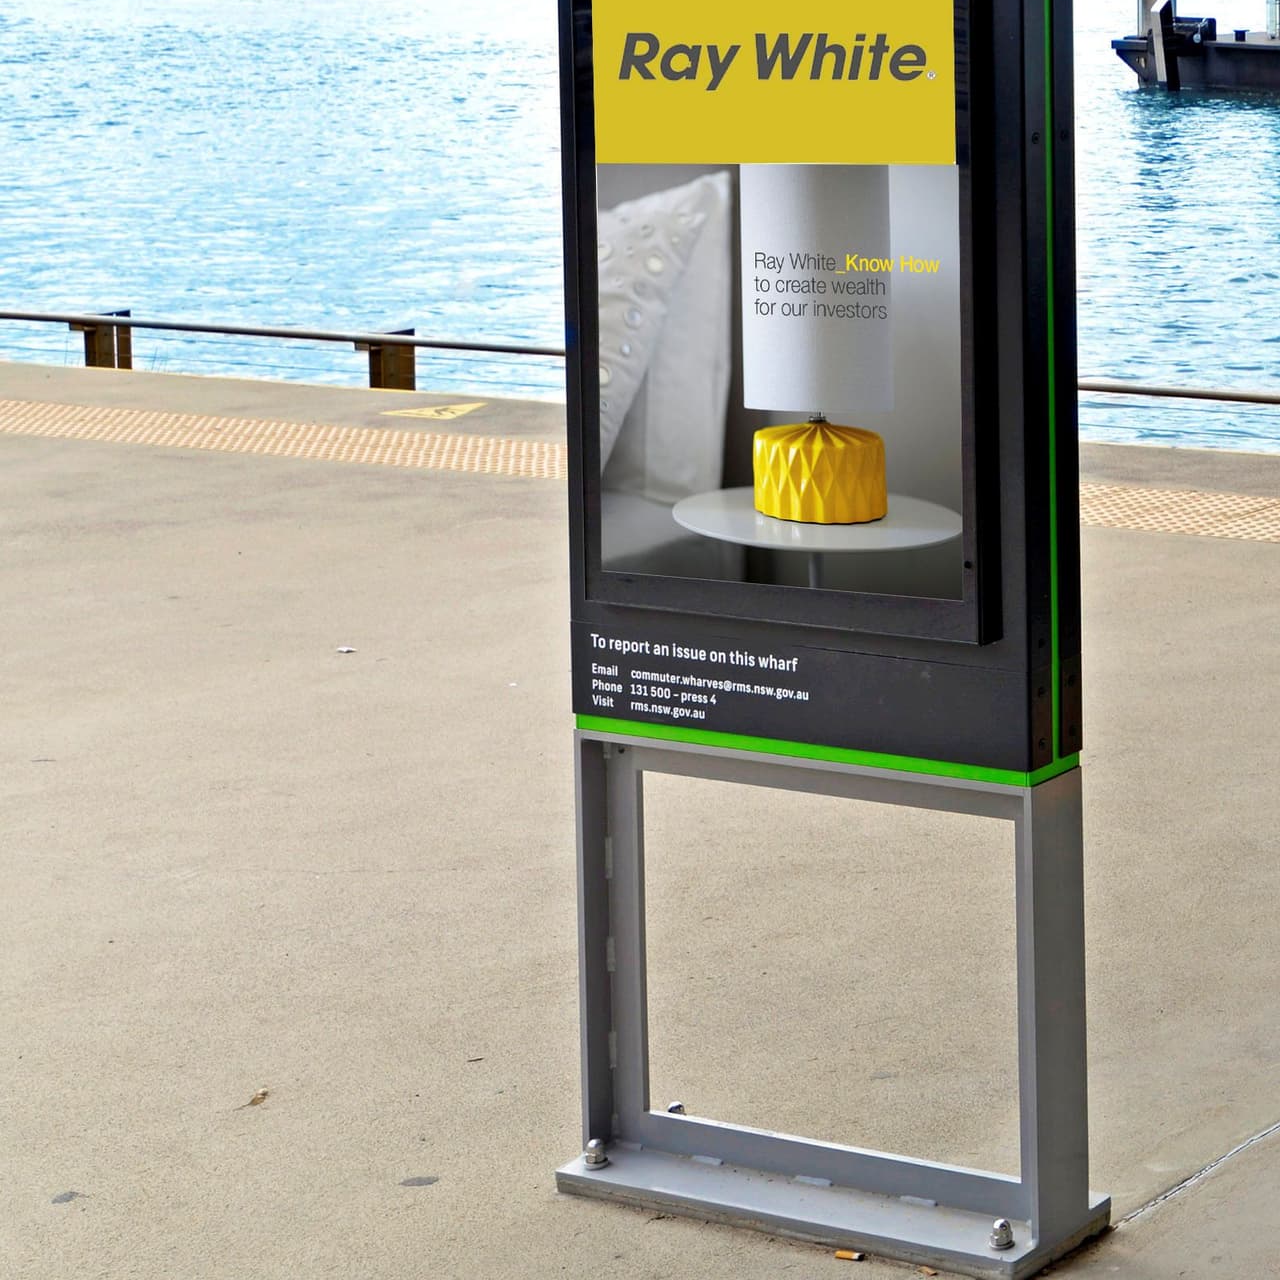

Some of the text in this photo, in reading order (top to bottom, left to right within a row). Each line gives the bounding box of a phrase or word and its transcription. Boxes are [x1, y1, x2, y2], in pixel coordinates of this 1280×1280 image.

[618, 32, 927, 91] Ray White
[754, 251, 785, 274] Ray
[900, 255, 940, 273] How
[754, 276, 886, 296] to create wealth
[754, 298, 888, 320] for our investors
[590, 633, 799, 673] To report an issue on this wharf
[592, 663, 810, 701] Email commuter.wharves@rms.nsw.gov.au
[592, 679, 623, 693] Phone
[630, 684, 648, 697] 131
[650, 686, 671, 699] 500
[681, 692, 708, 704] press
[709, 694, 717, 705] 4
[592, 694, 706, 719] Visit rms.nsw.gov.au
